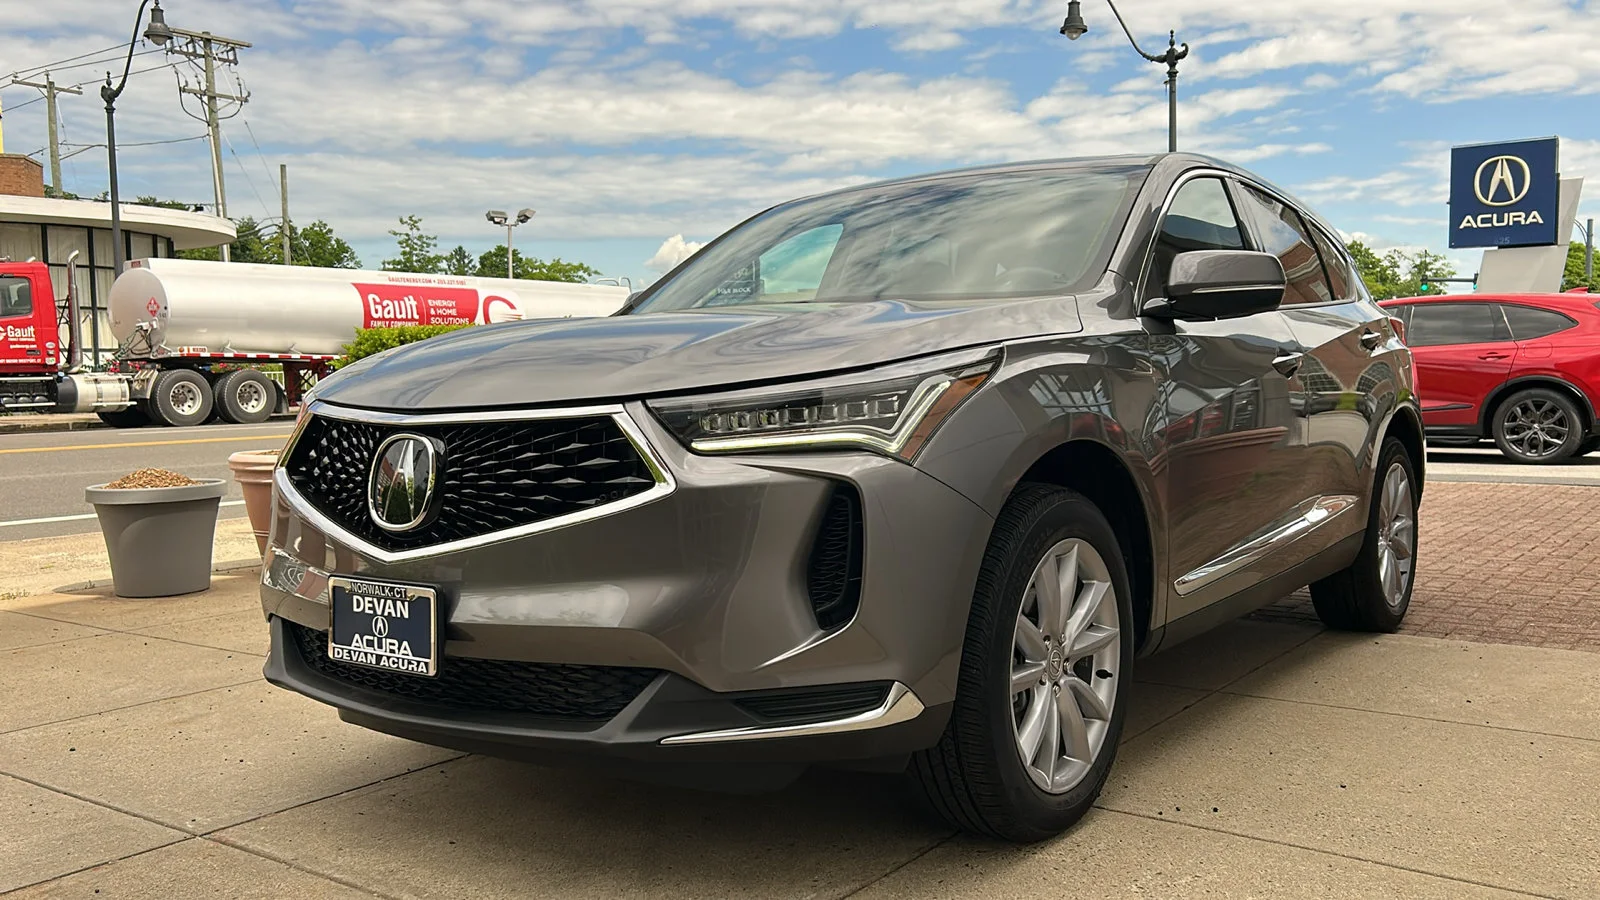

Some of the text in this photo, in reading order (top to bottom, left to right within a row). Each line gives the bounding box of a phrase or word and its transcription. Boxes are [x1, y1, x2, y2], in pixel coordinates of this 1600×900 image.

[1459, 210, 1544, 229] ACURA
[367, 293, 419, 320] Gault
[427, 299, 456, 308] ENERGY
[437, 308, 458, 316] HOME
[370, 320, 389, 328] FAMILY
[430, 316, 469, 326] SOLUTIONS
[7, 325, 36, 338] Gault
[352, 595, 409, 618] DEVAN
[351, 633, 413, 658] ACURA
[334, 647, 427, 673] DEVAN ACURA
